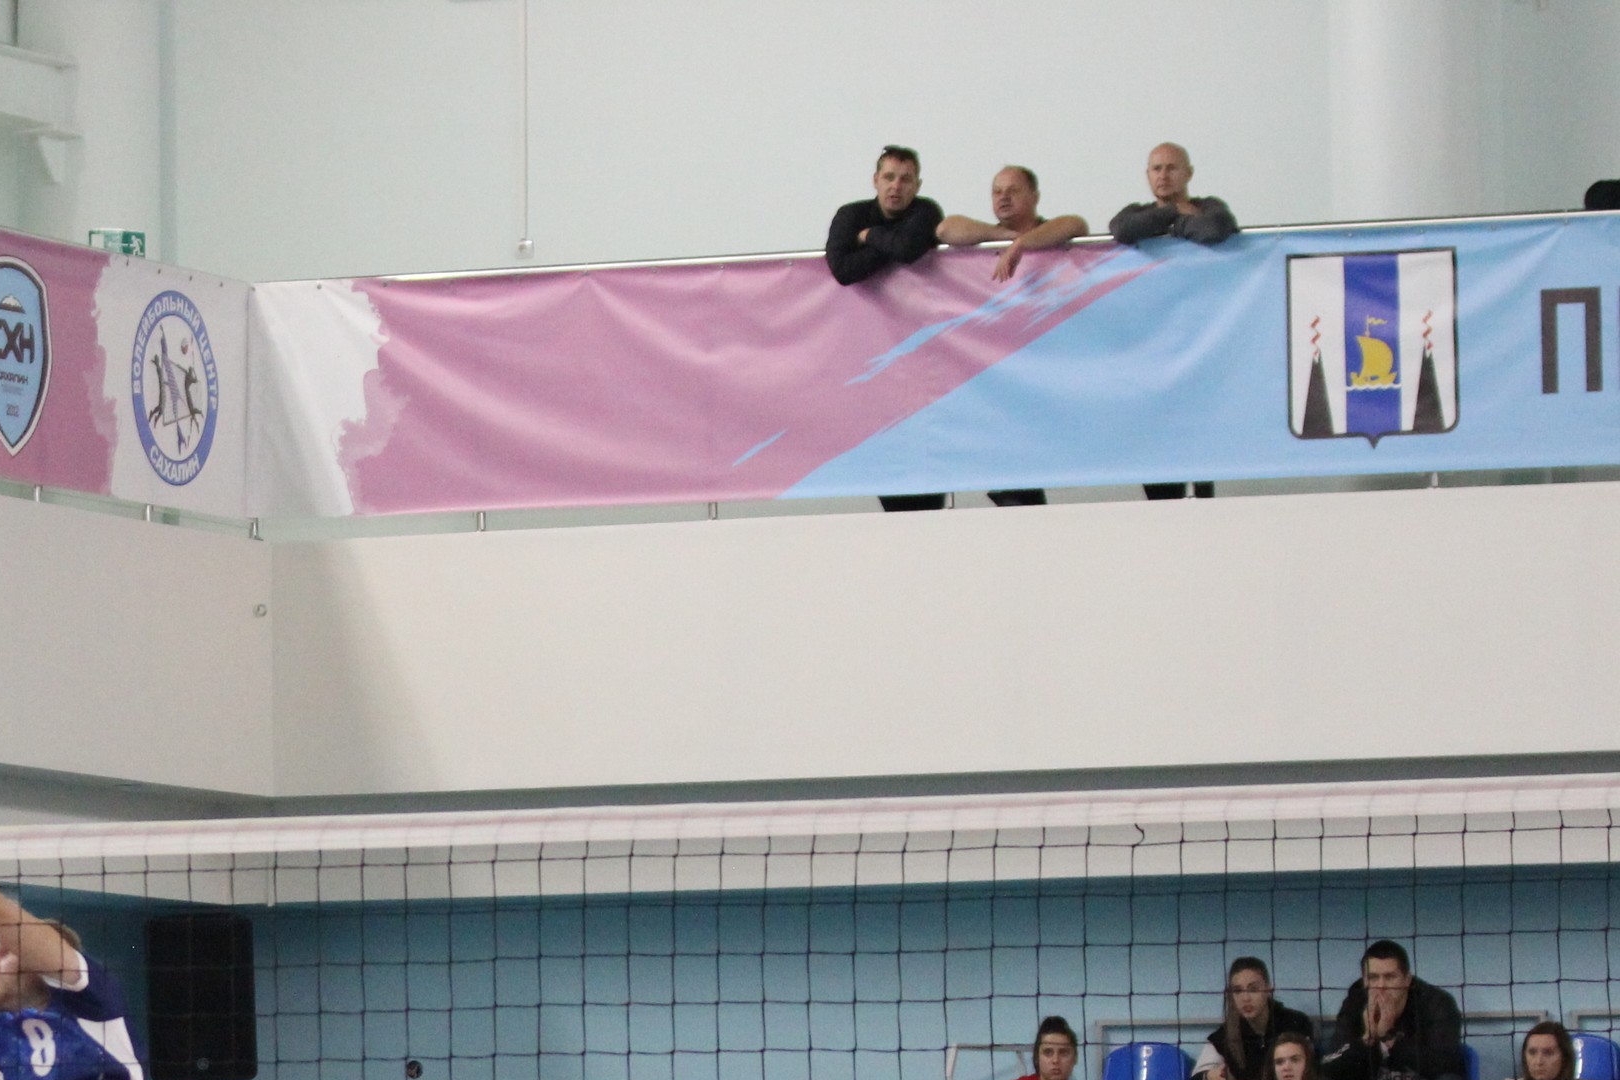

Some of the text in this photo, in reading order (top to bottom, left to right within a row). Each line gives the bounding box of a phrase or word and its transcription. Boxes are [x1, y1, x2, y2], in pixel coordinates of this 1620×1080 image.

[198, 328, 217, 411] ЦЕНТР
[149, 445, 201, 482] САХАЛИН
[22, 1018, 56, 1077] 8
